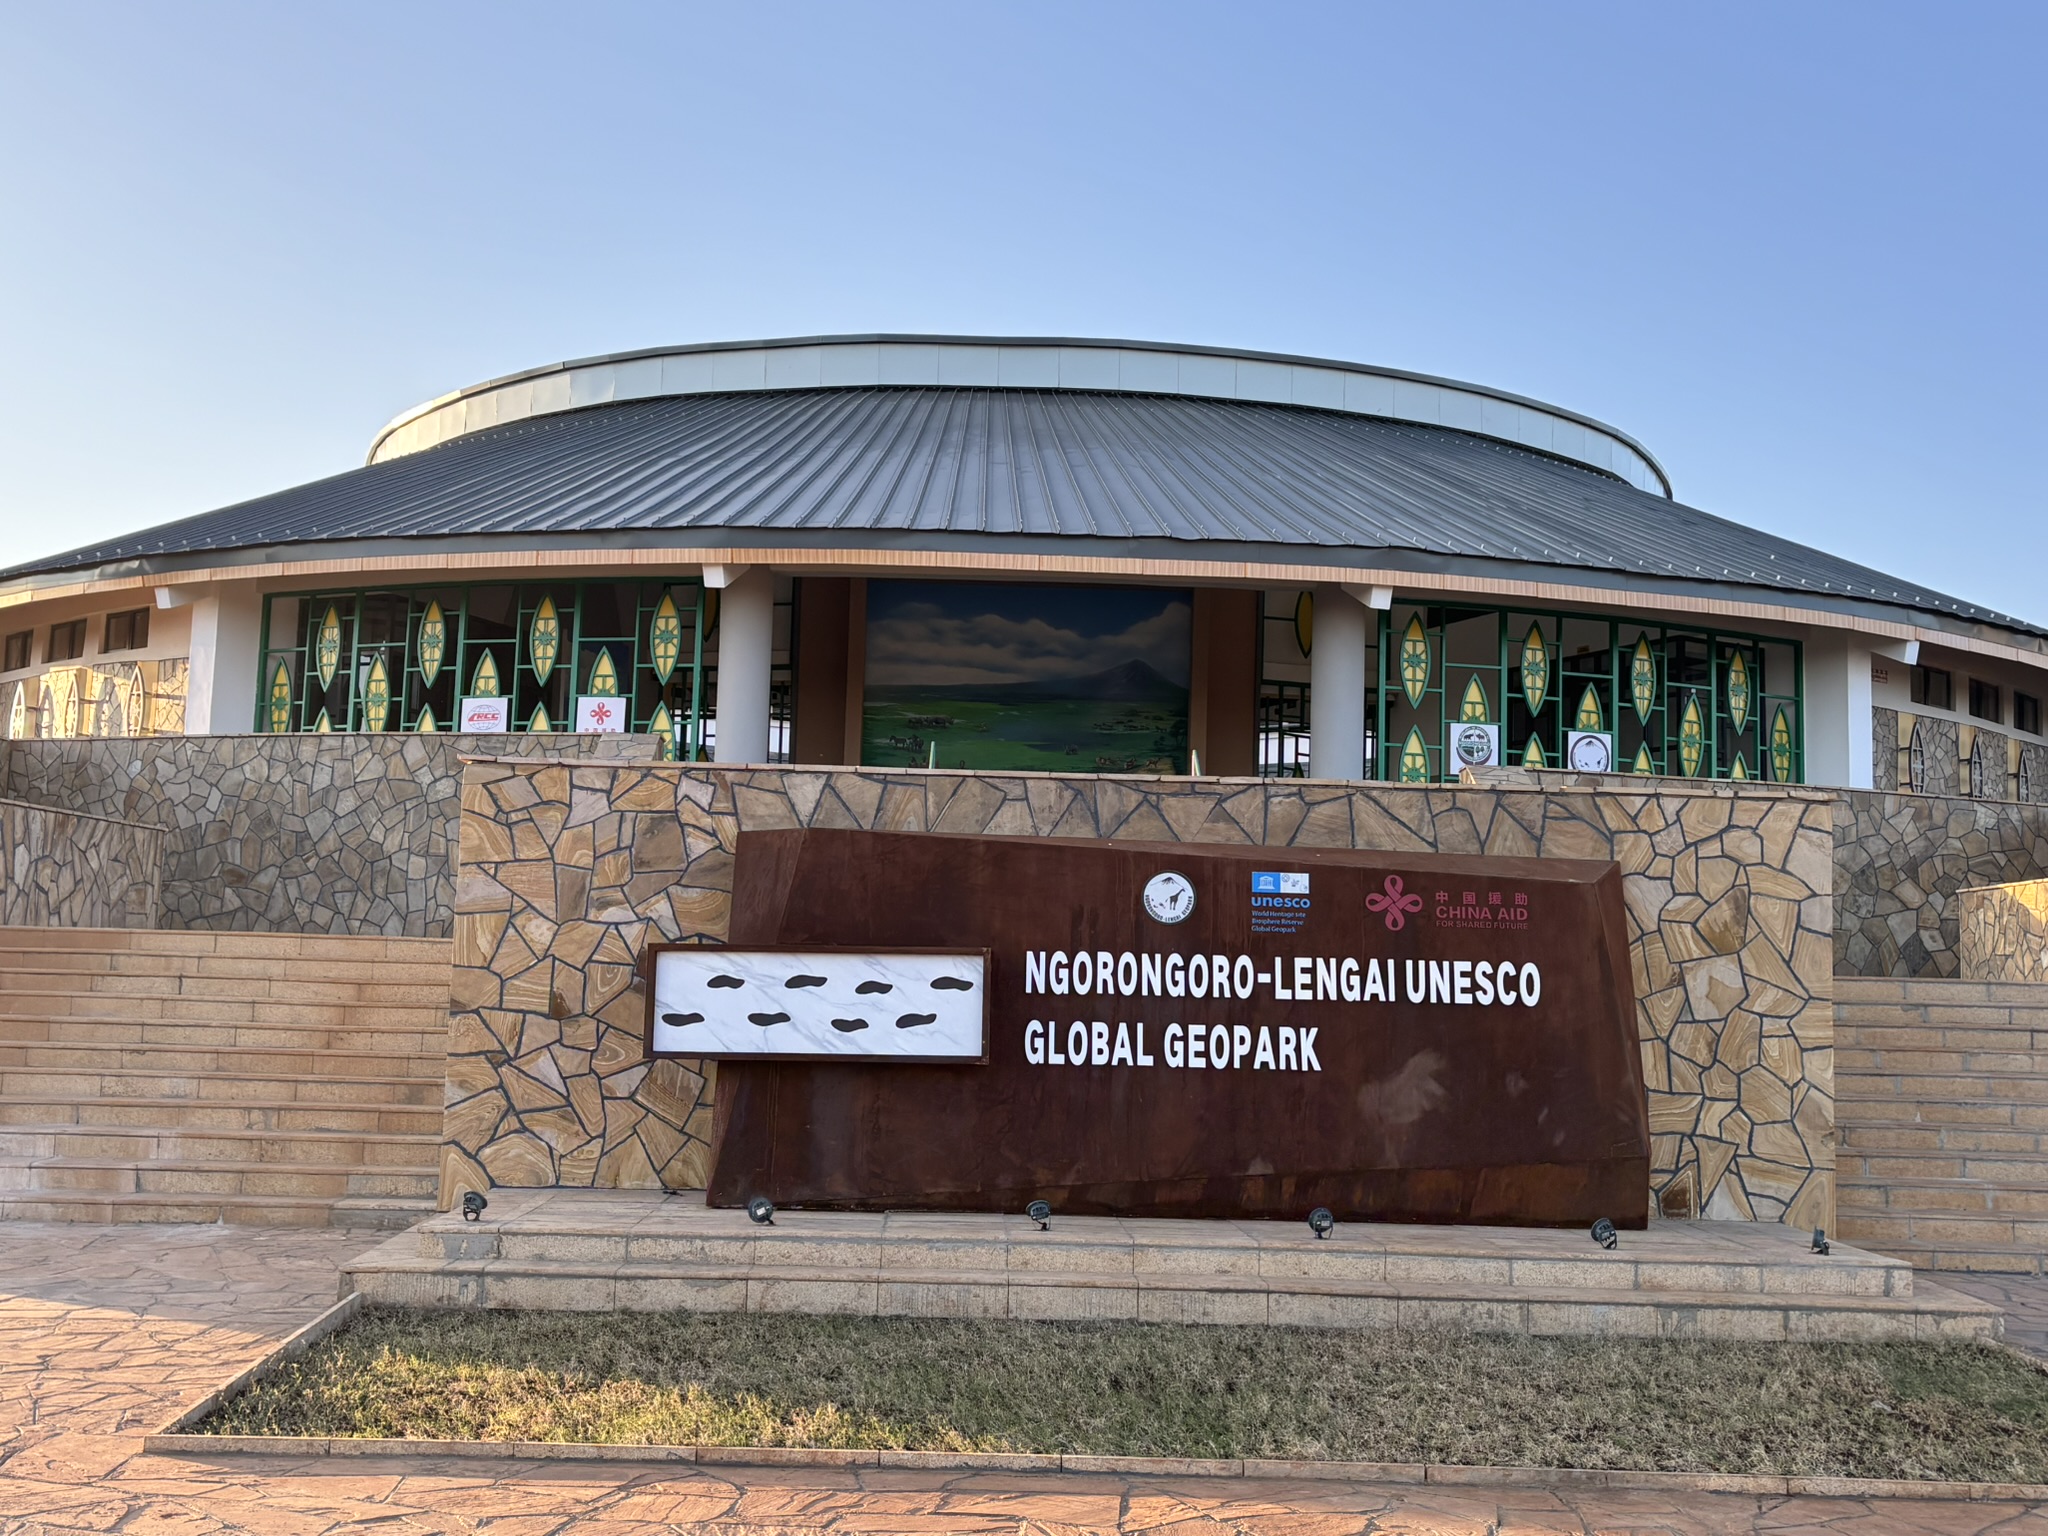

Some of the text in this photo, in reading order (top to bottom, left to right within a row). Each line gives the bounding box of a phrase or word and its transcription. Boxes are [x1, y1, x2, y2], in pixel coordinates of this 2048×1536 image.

[1251, 896, 1311, 909] unesco
[1435, 890, 1528, 905] 中国援助
[1251, 910, 1269, 918] World
[1269, 911, 1295, 919] Heritage
[1436, 906, 1528, 920] CHINA AID
[1251, 918, 1280, 926] Biosphere
[1436, 920, 1528, 930] FOR SHARED FUTURE
[1251, 925, 1297, 934] Global Geopark
[1024, 950, 1542, 1007] NGORONGORO-LENGAI UNESCO
[1024, 1019, 1322, 1072] GLOBAL GEOPARK
